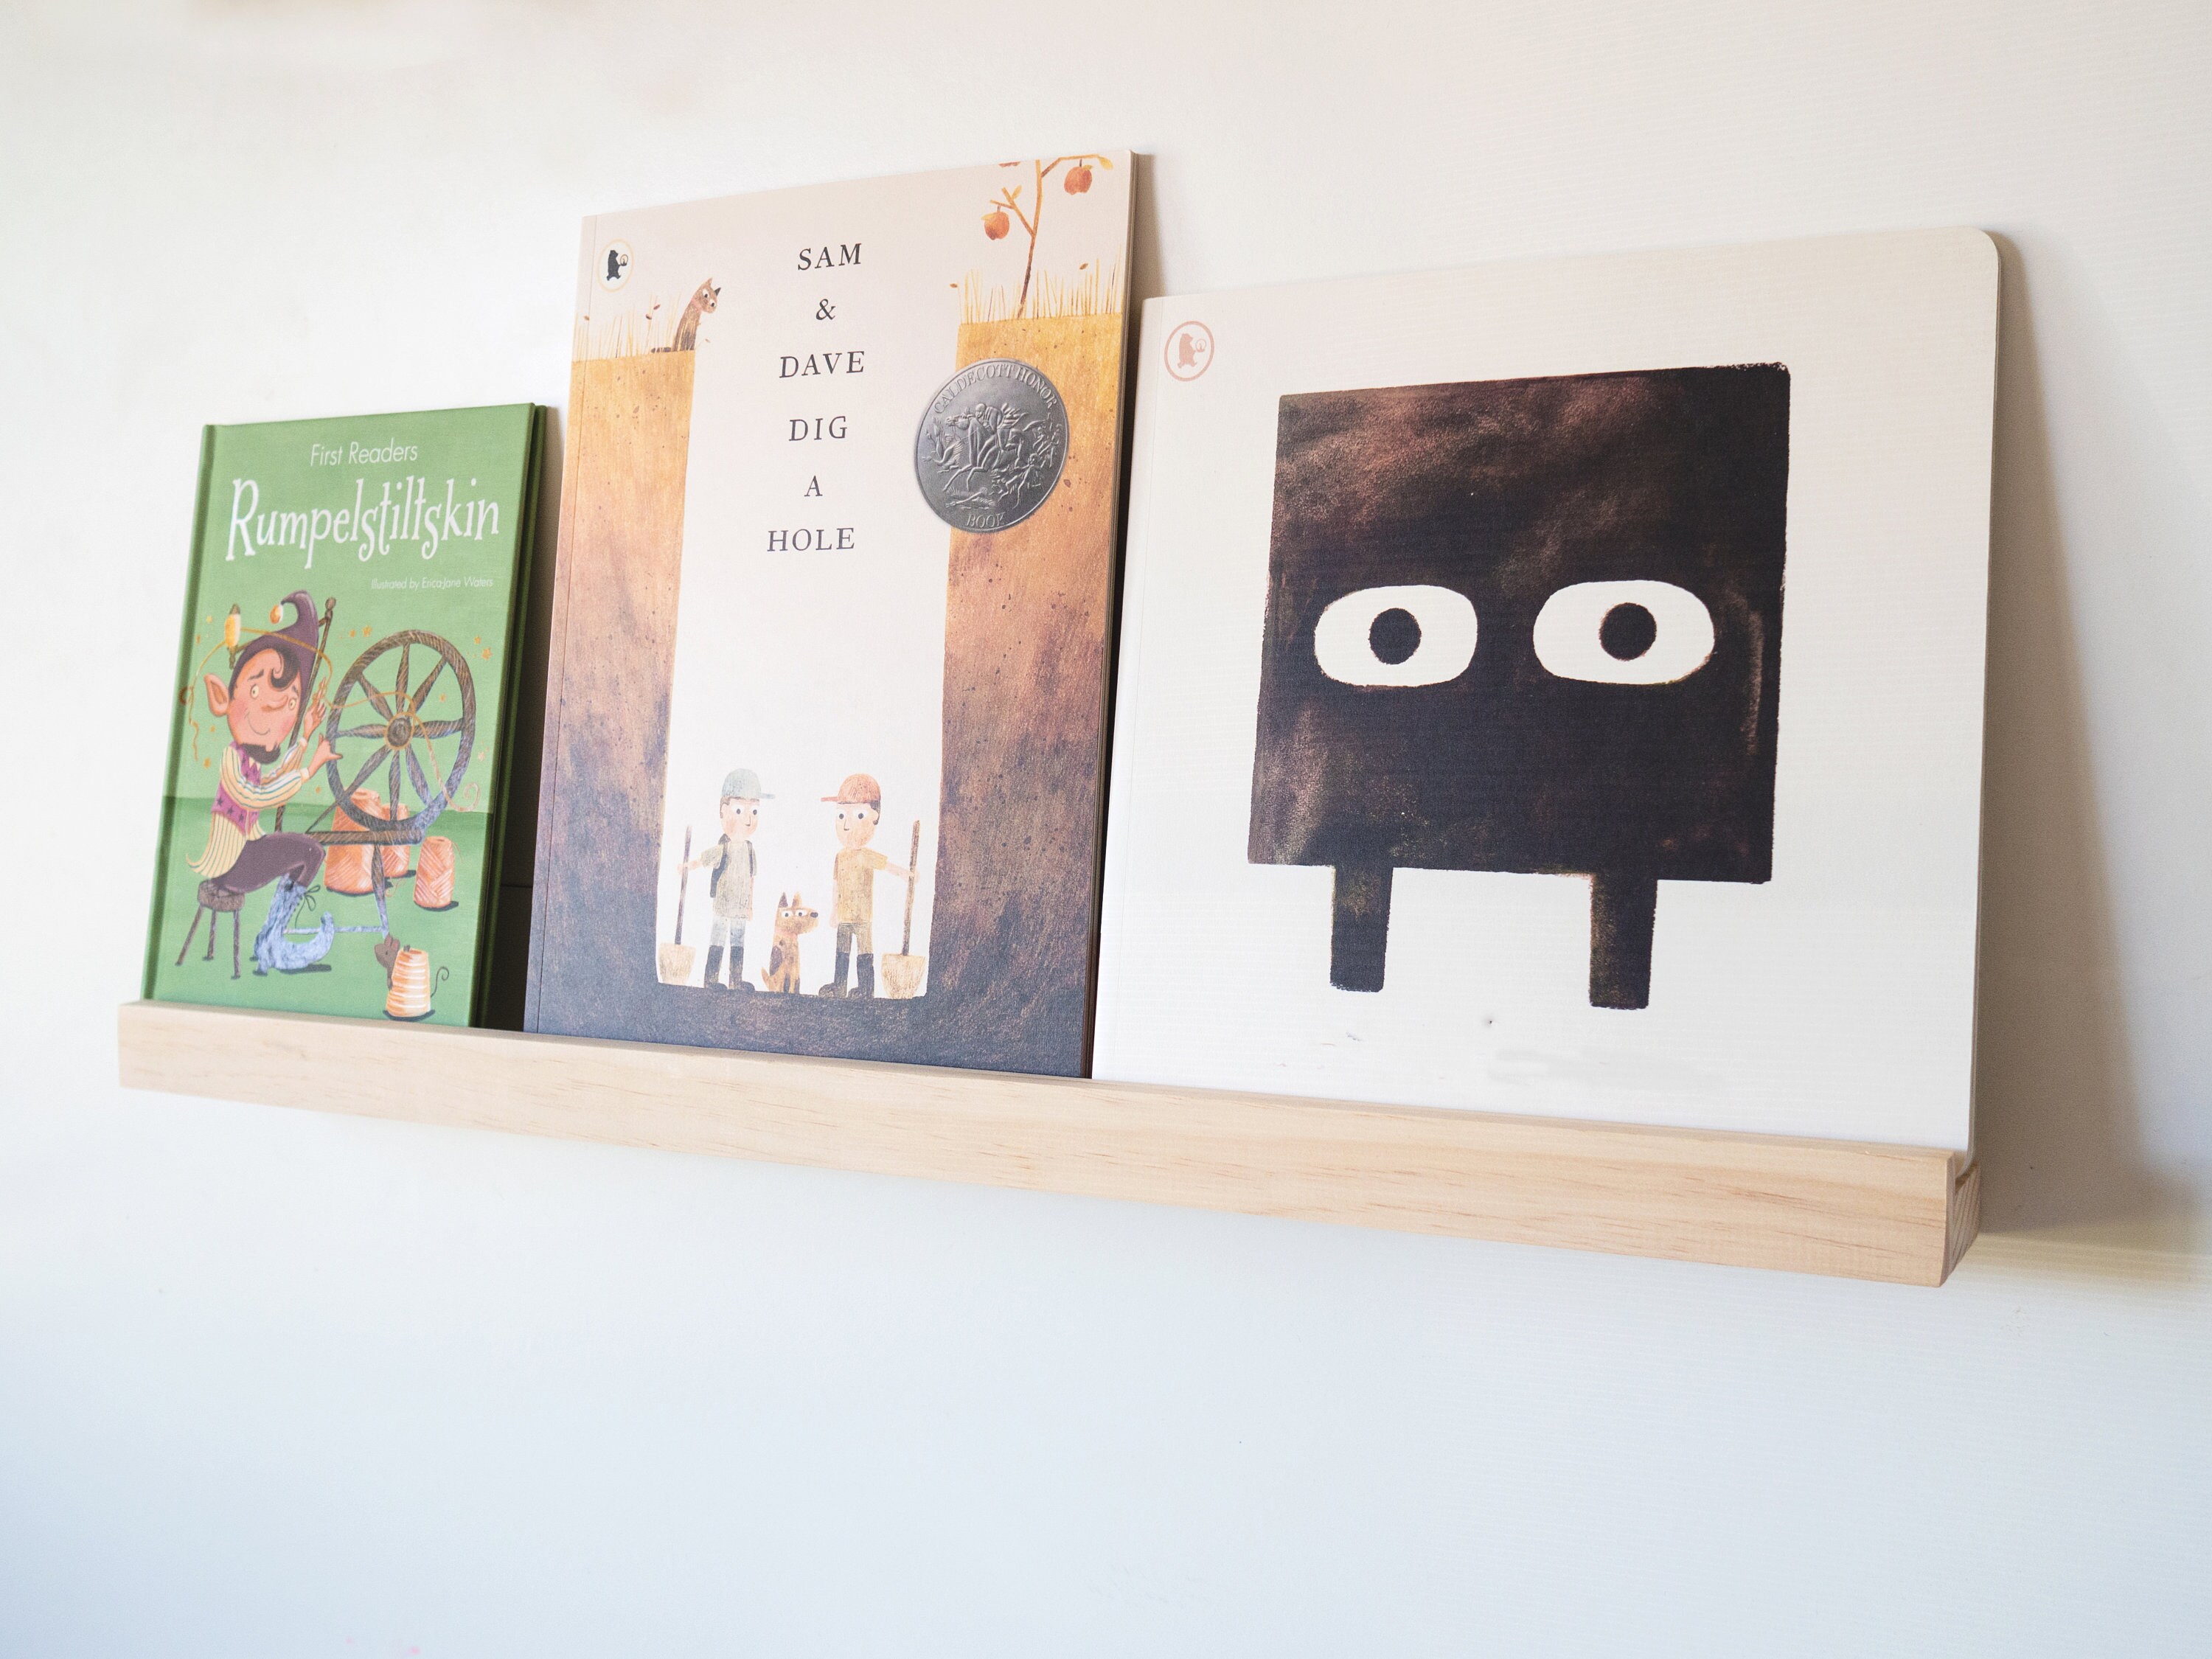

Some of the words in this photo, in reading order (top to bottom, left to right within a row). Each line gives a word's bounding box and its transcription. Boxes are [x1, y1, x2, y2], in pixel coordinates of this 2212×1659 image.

[797, 243, 862, 271] SAM
[815, 298, 836, 321] &
[779, 350, 865, 379] DAVE
[933, 364, 1015, 414] CALDECOTT
[1015, 364, 1057, 409] HONOR
[788, 415, 848, 442] DIG
[310, 443, 343, 467] First
[348, 437, 418, 464] Readers
[804, 475, 824, 497] A
[225, 475, 500, 569] Rumpelstiltskin
[766, 527, 855, 552] HOLE
[371, 577, 407, 590] Illustrated
[408, 577, 420, 591] by
[421, 577, 461, 590] Erica-Jane
[464, 577, 494, 588] Waters
